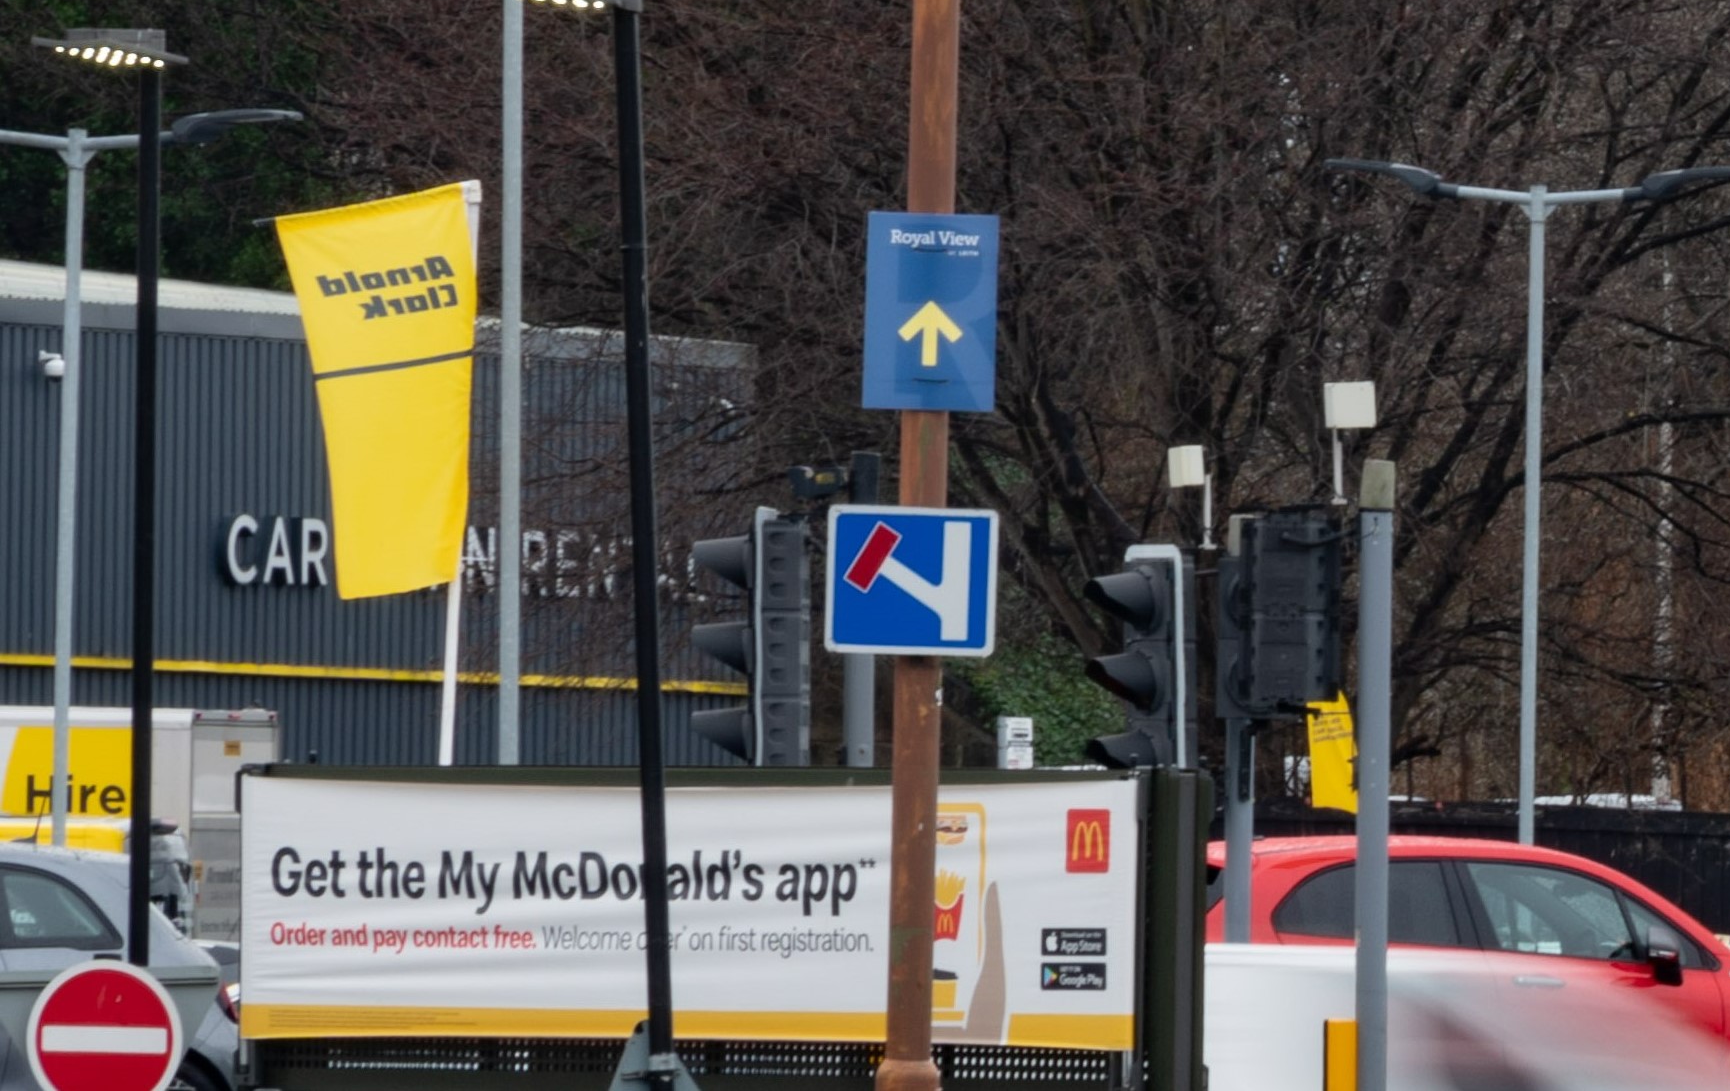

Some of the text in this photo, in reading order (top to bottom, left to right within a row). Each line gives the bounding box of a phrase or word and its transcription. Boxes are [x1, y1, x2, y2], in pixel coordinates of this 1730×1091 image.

[890, 229, 979, 248] Royal View
[226, 514, 328, 585] CAR
[26, 774, 126, 814] Hire
[271, 847, 345, 899] Get
[357, 847, 425, 899] the
[438, 850, 500, 915] My
[271, 922, 326, 946] Order
[331, 923, 368, 947] and
[373, 928, 408, 954] pay
[412, 925, 488, 949] contact
[494, 924, 537, 950] free.
[543, 924, 631, 952] Welcome
[688, 932, 713, 952] on
[718, 925, 757, 952] first
[760, 927, 874, 959] registration.
